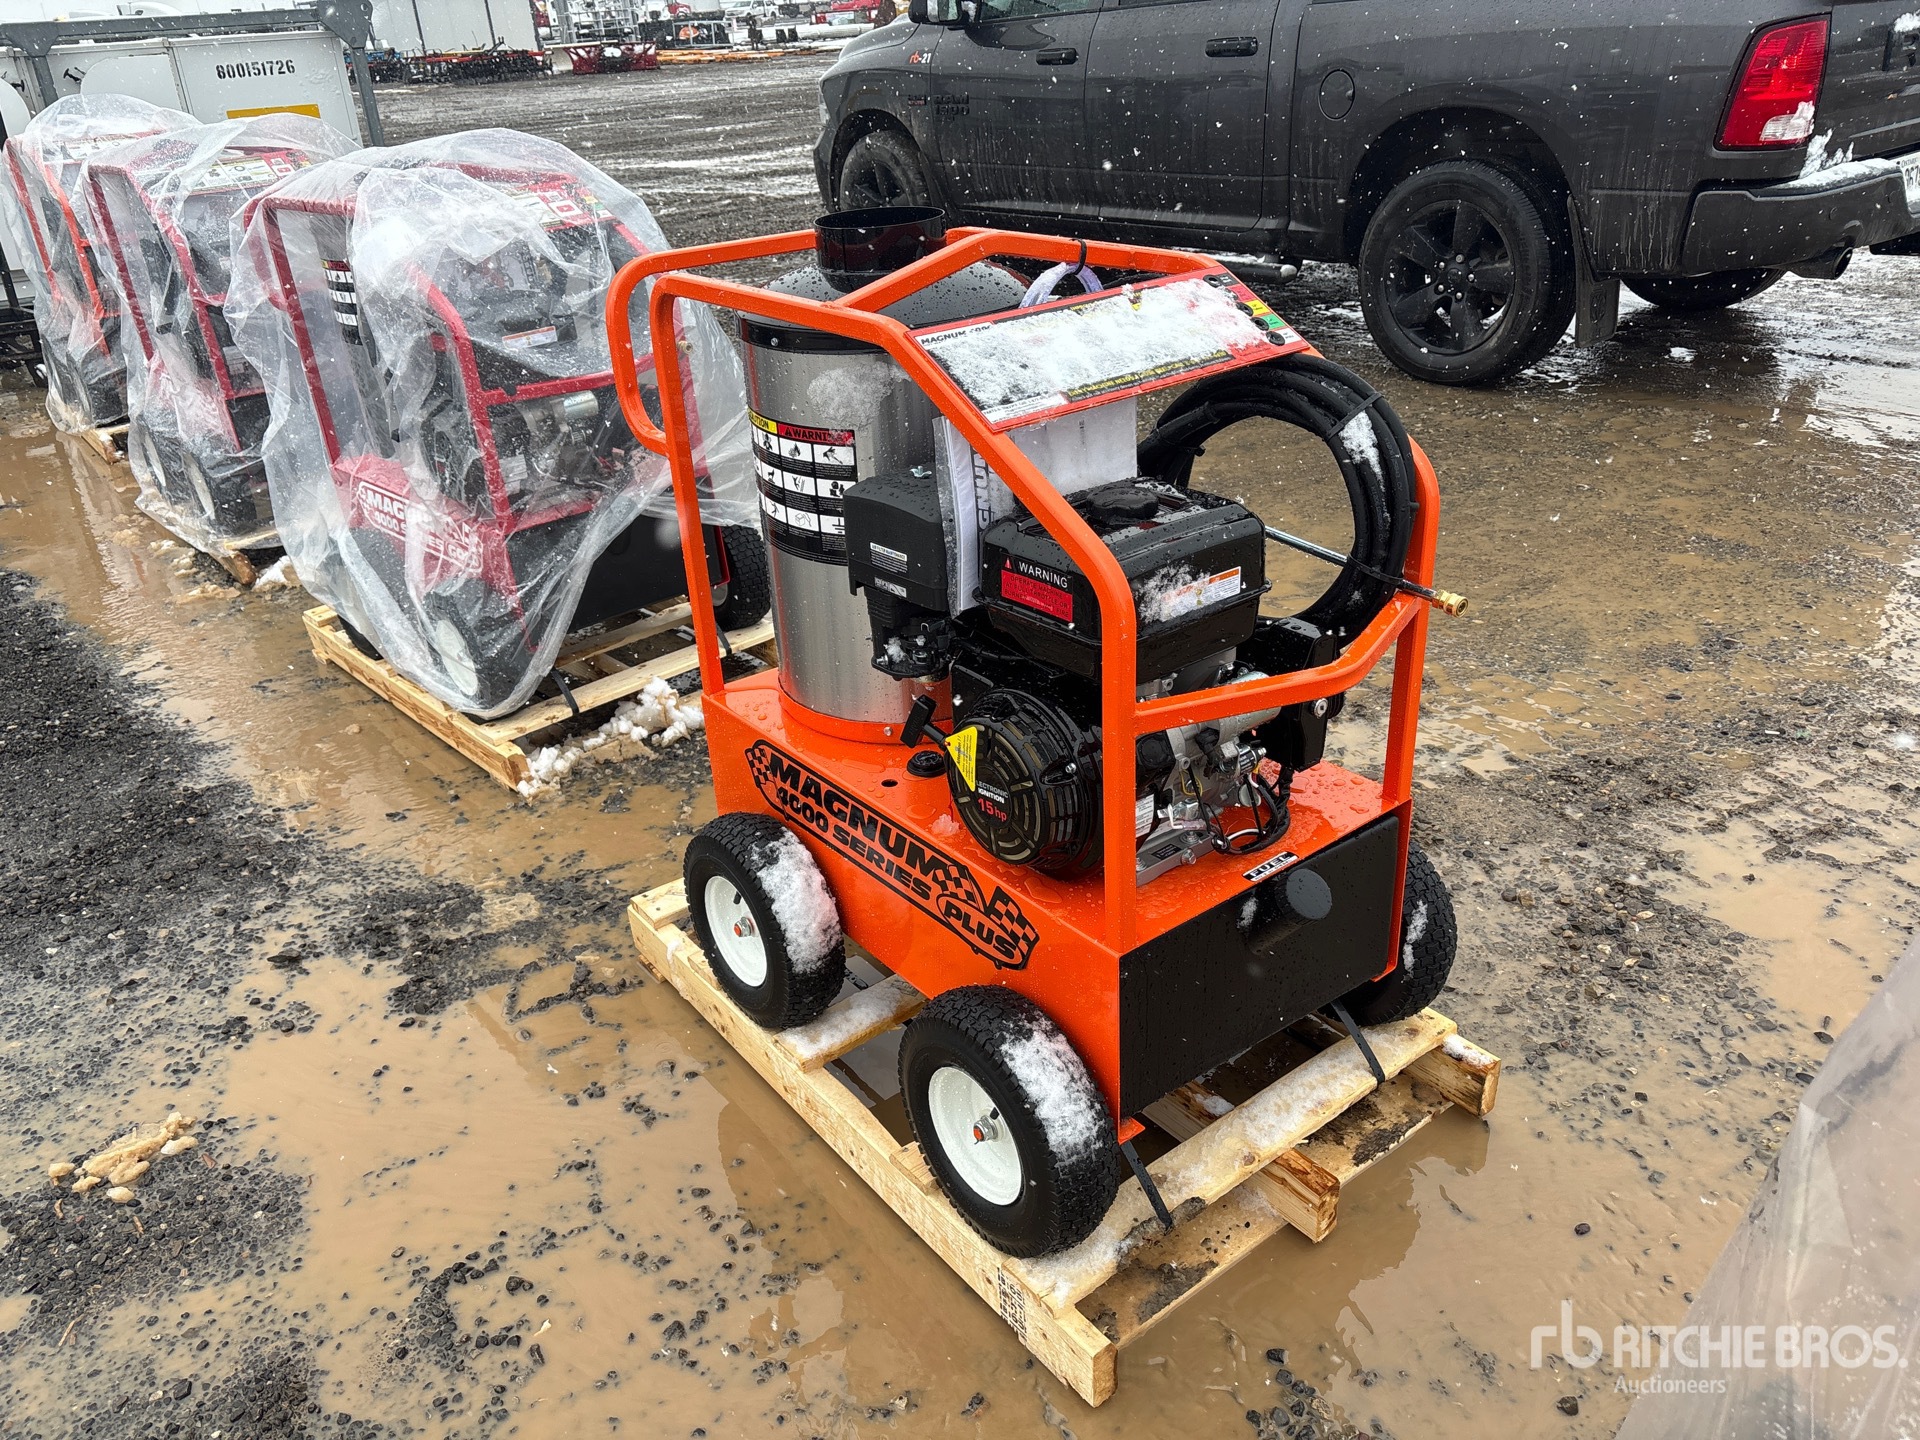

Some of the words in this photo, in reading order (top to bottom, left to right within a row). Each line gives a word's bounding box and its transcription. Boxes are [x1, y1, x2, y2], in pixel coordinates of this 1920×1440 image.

[215, 59, 295, 79] 800151726
[921, 330, 967, 345] MAGNUM
[1011, 576, 1037, 587] OPERATE
[1019, 561, 1068, 588] WARNING
[976, 780, 1009, 798] LECTRONIC
[977, 787, 1005, 804] IGNITION
[769, 753, 944, 877] MAGNUM
[776, 786, 829, 833] 4000
[833, 824, 932, 901] SERIES
[943, 899, 1017, 959] PLUS
[1250, 852, 1293, 877] FUEL
